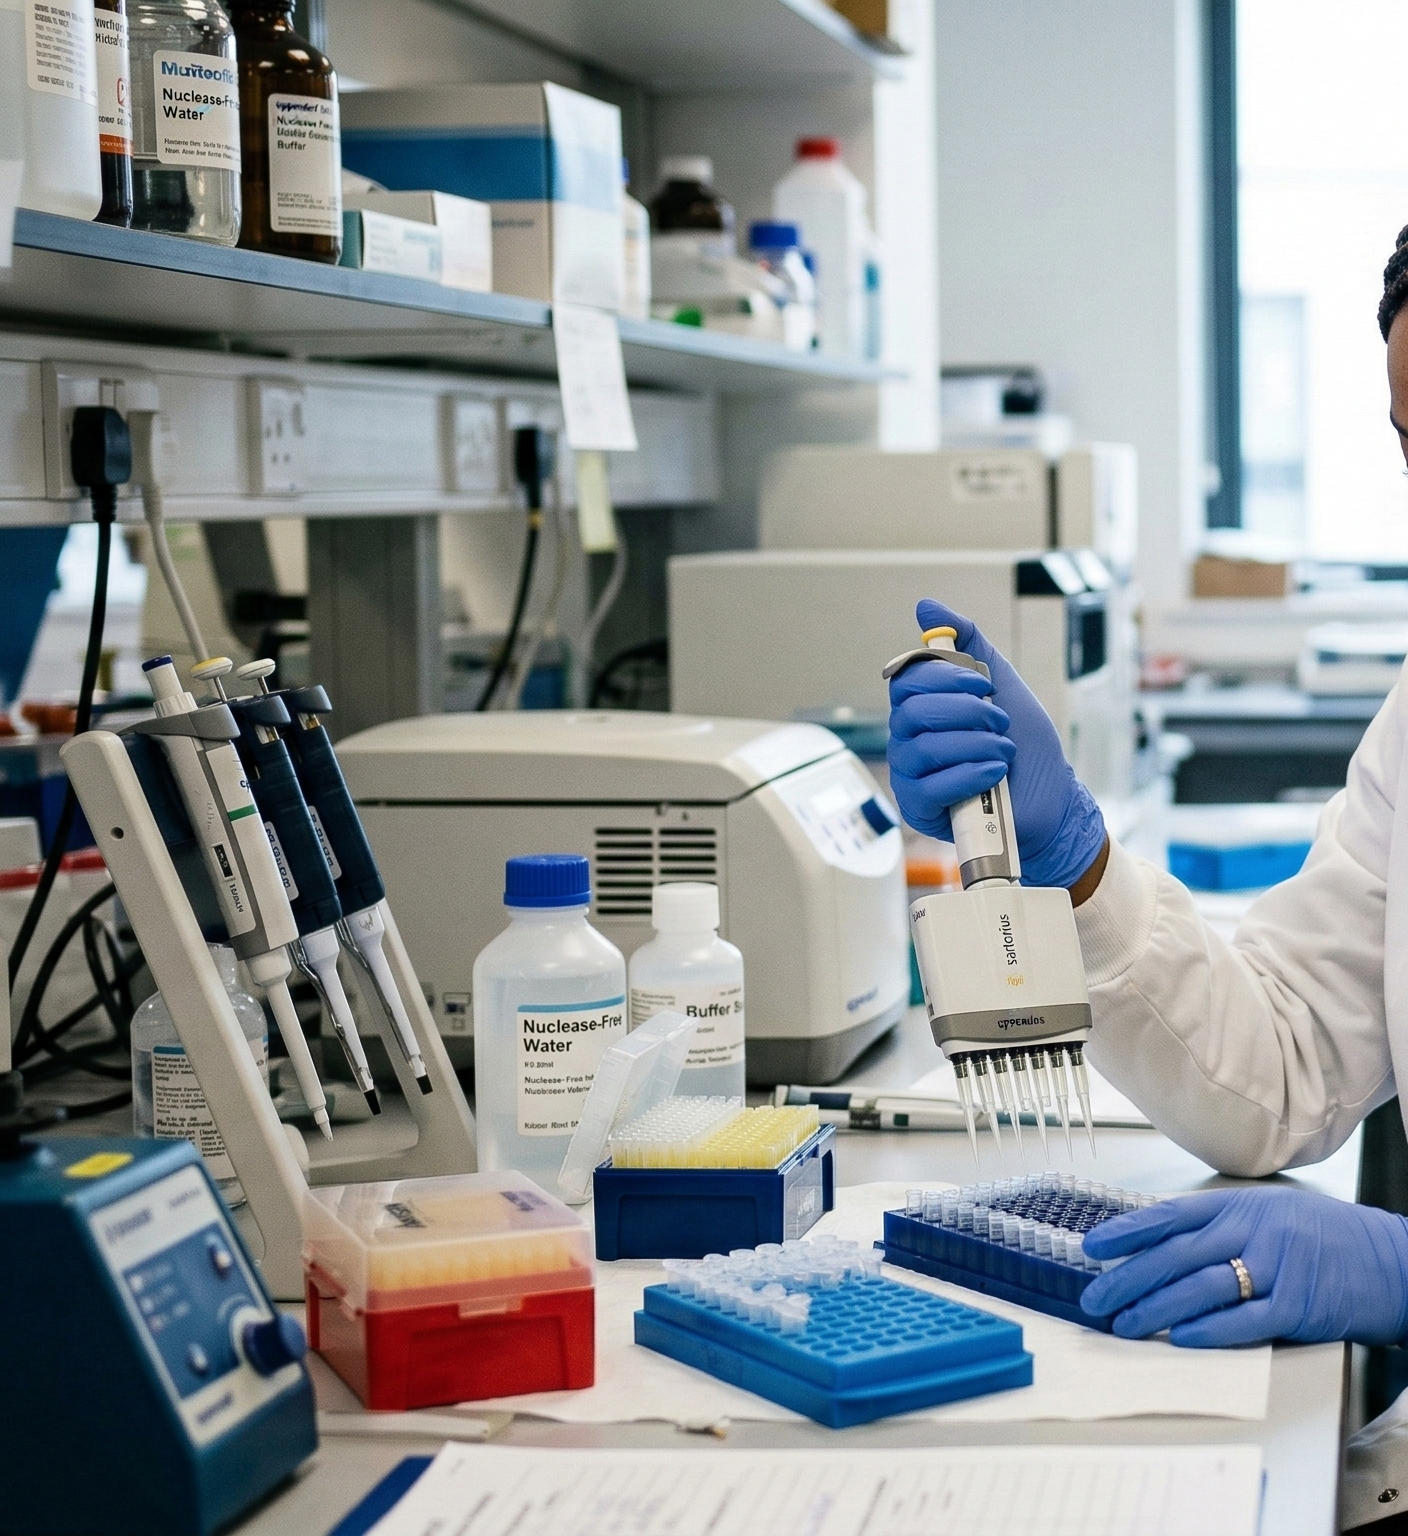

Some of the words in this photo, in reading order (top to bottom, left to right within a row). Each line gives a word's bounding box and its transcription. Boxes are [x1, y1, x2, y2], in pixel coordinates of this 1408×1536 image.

[162, 105, 204, 121] Water
[685, 1002, 731, 1018] Buffer
[522, 1037, 573, 1053] Water
